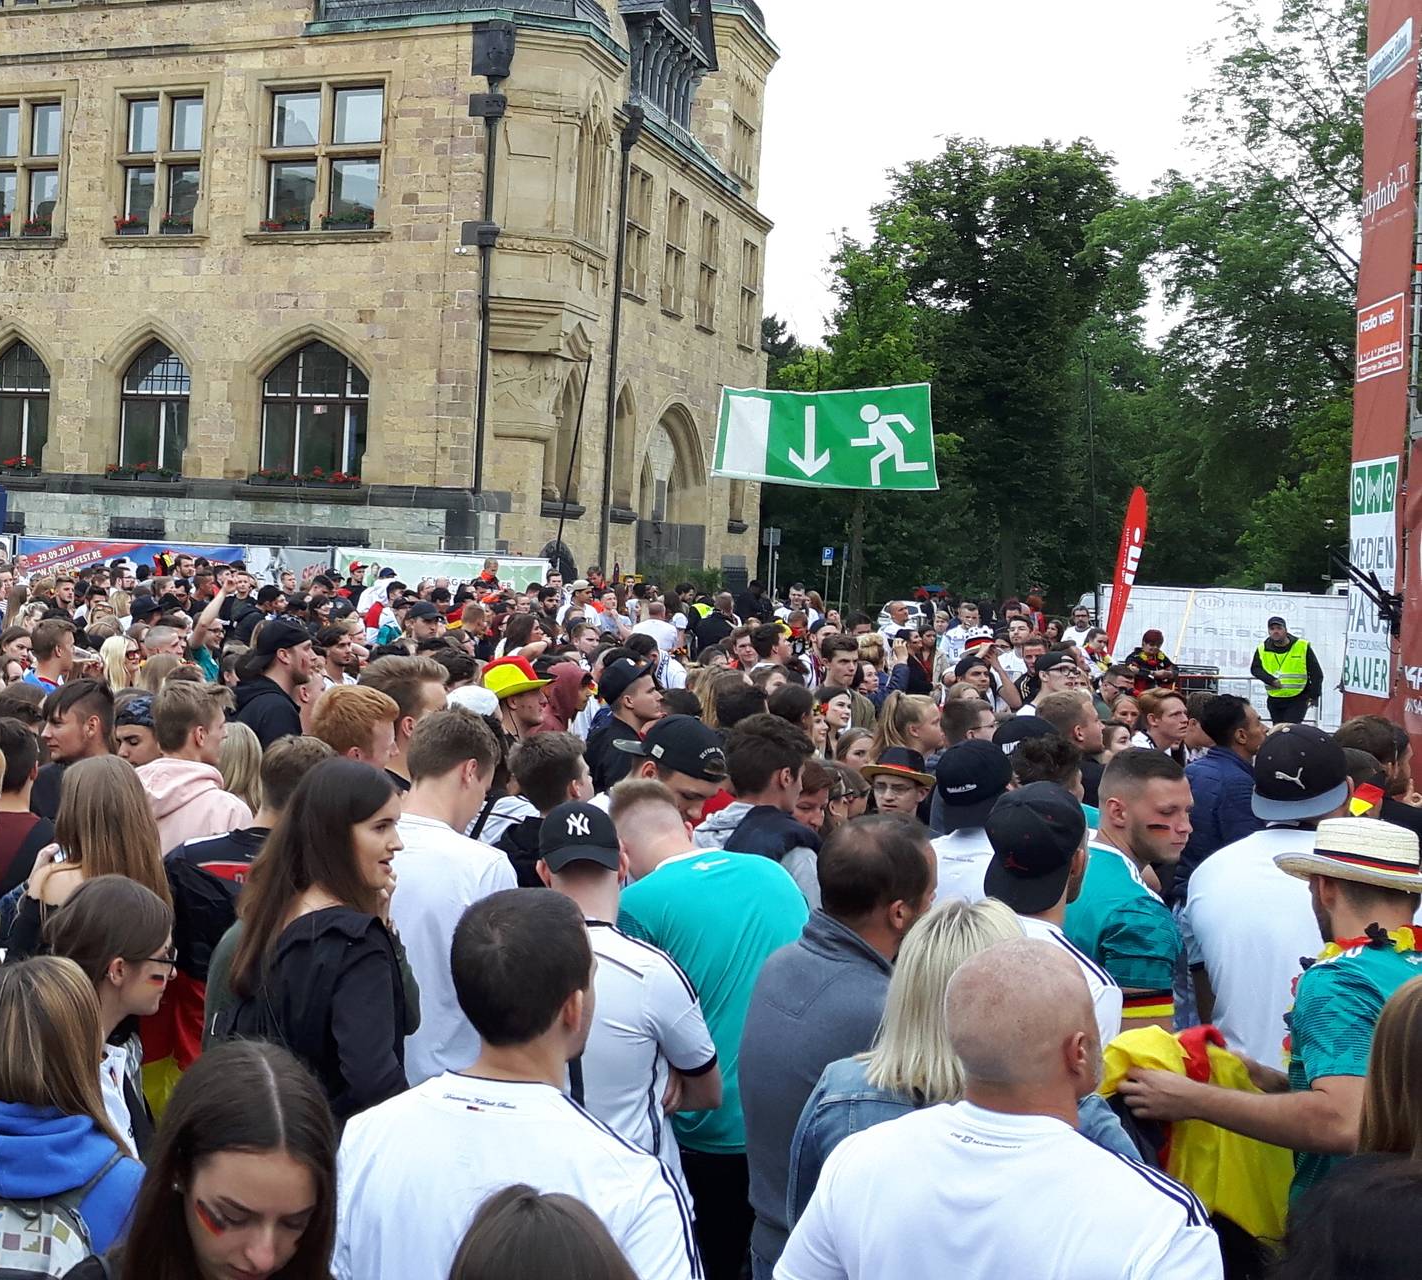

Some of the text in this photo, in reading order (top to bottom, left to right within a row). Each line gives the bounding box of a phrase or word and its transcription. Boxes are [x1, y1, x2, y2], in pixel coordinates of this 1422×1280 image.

[1379, 308, 1394, 325] vest
[38, 544, 75, 563] 29.09.2018
[1350, 536, 1394, 569] MEDIEN
[1344, 655, 1388, 692] BAUER
[566, 812, 591, 835] NY
